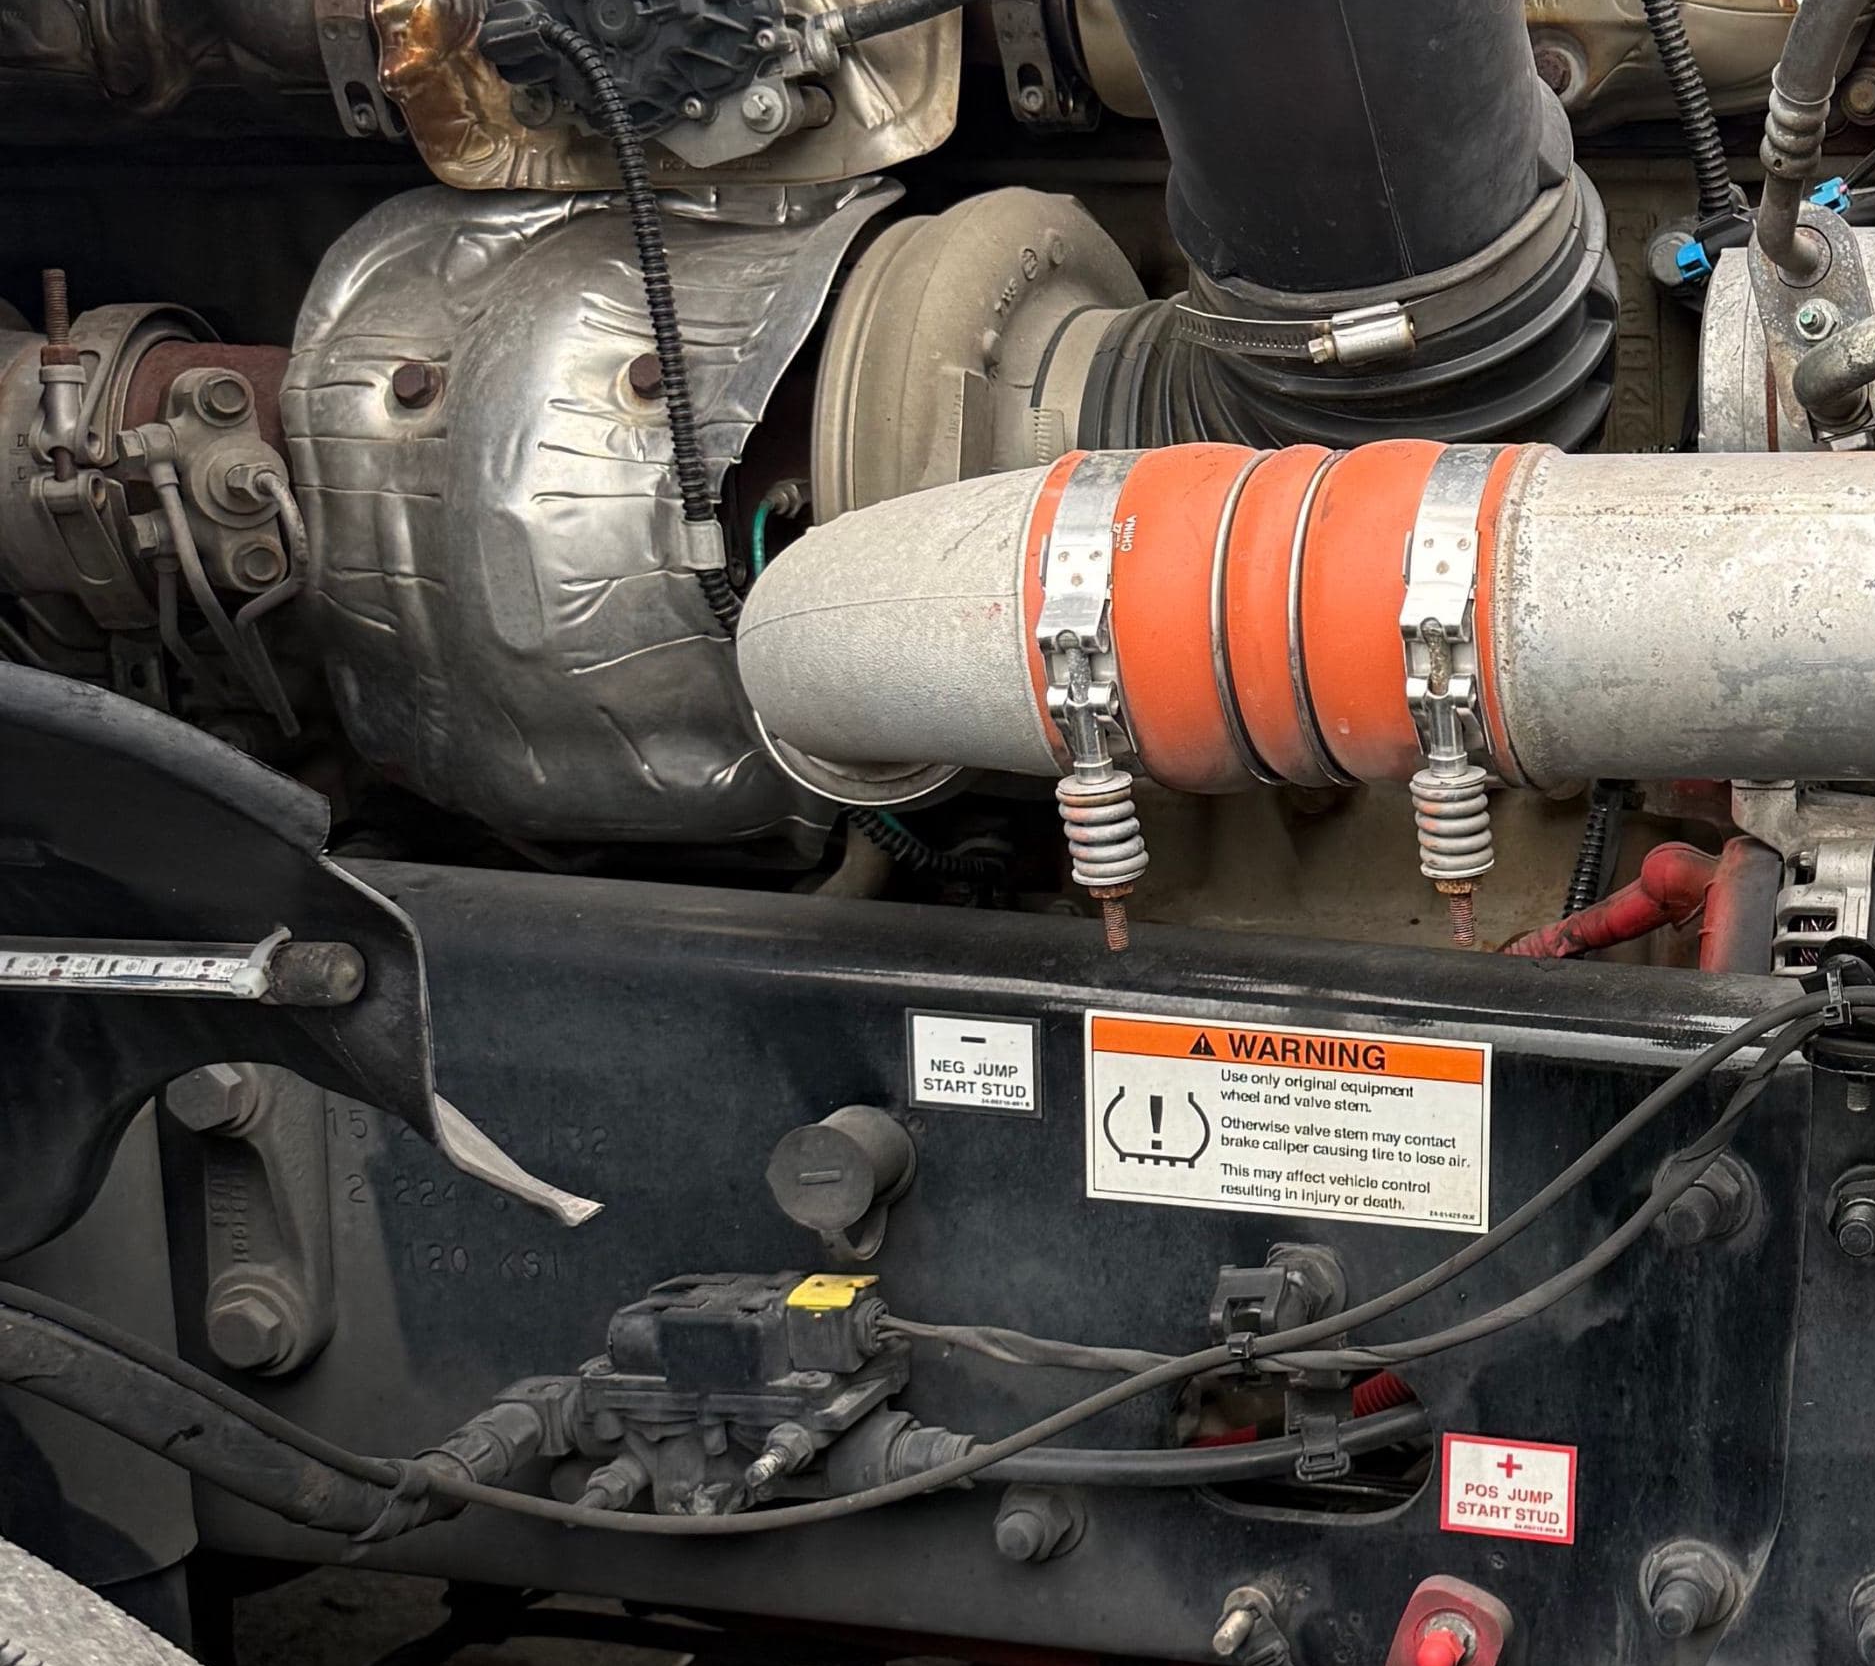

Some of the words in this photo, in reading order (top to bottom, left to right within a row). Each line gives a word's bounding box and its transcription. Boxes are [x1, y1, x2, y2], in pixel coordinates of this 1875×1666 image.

[1120, 514, 1138, 552] CHINA
[1228, 1033, 1386, 1071] WARNING
[931, 1059, 965, 1074] NEG
[974, 1063, 1018, 1078] JUMP
[923, 1078, 976, 1093] START
[982, 1083, 1026, 1098] STUD
[1221, 1068, 1248, 1083] Use
[1251, 1073, 1280, 1089] only
[1285, 1075, 1337, 1091] original
[1341, 1082, 1414, 1098] equipment
[1220, 1089, 1260, 1103] wheel
[1264, 1093, 1290, 1106] and
[1294, 1096, 1331, 1109] valve
[1334, 1099, 1372, 1113] stem.
[1221, 1116, 1290, 1134] Otherwise
[1294, 1123, 1331, 1138] valve
[1334, 1127, 1368, 1141] stem
[1372, 1132, 1401, 1147] may
[1404, 1134, 1457, 1149] contact
[1221, 1133, 1260, 1149] brake
[1262, 1138, 1309, 1155] caliper
[1313, 1143, 1368, 1162] causing
[1372, 1147, 1395, 1161] tire
[1398, 1149, 1412, 1163] to
[1416, 1151, 1445, 1166] lose
[1448, 1155, 1471, 1169] air.
[1220, 1163, 1250, 1177] This
[1253, 1168, 1283, 1183] may
[1286, 1169, 1325, 1184] affect
[1329, 1173, 1378, 1189] vehicle
[1382, 1180, 1431, 1194] control
[1220, 1184, 1281, 1201] resulting
[1285, 1187, 1298, 1200] in
[1302, 1188, 1341, 1207] injury
[1344, 1195, 1359, 1206] or
[1362, 1195, 1406, 1211] death.
[1465, 1483, 1499, 1499] POS
[1507, 1488, 1553, 1504] JUMP
[1457, 1502, 1512, 1520] START
[1515, 1508, 1560, 1525] STUD
